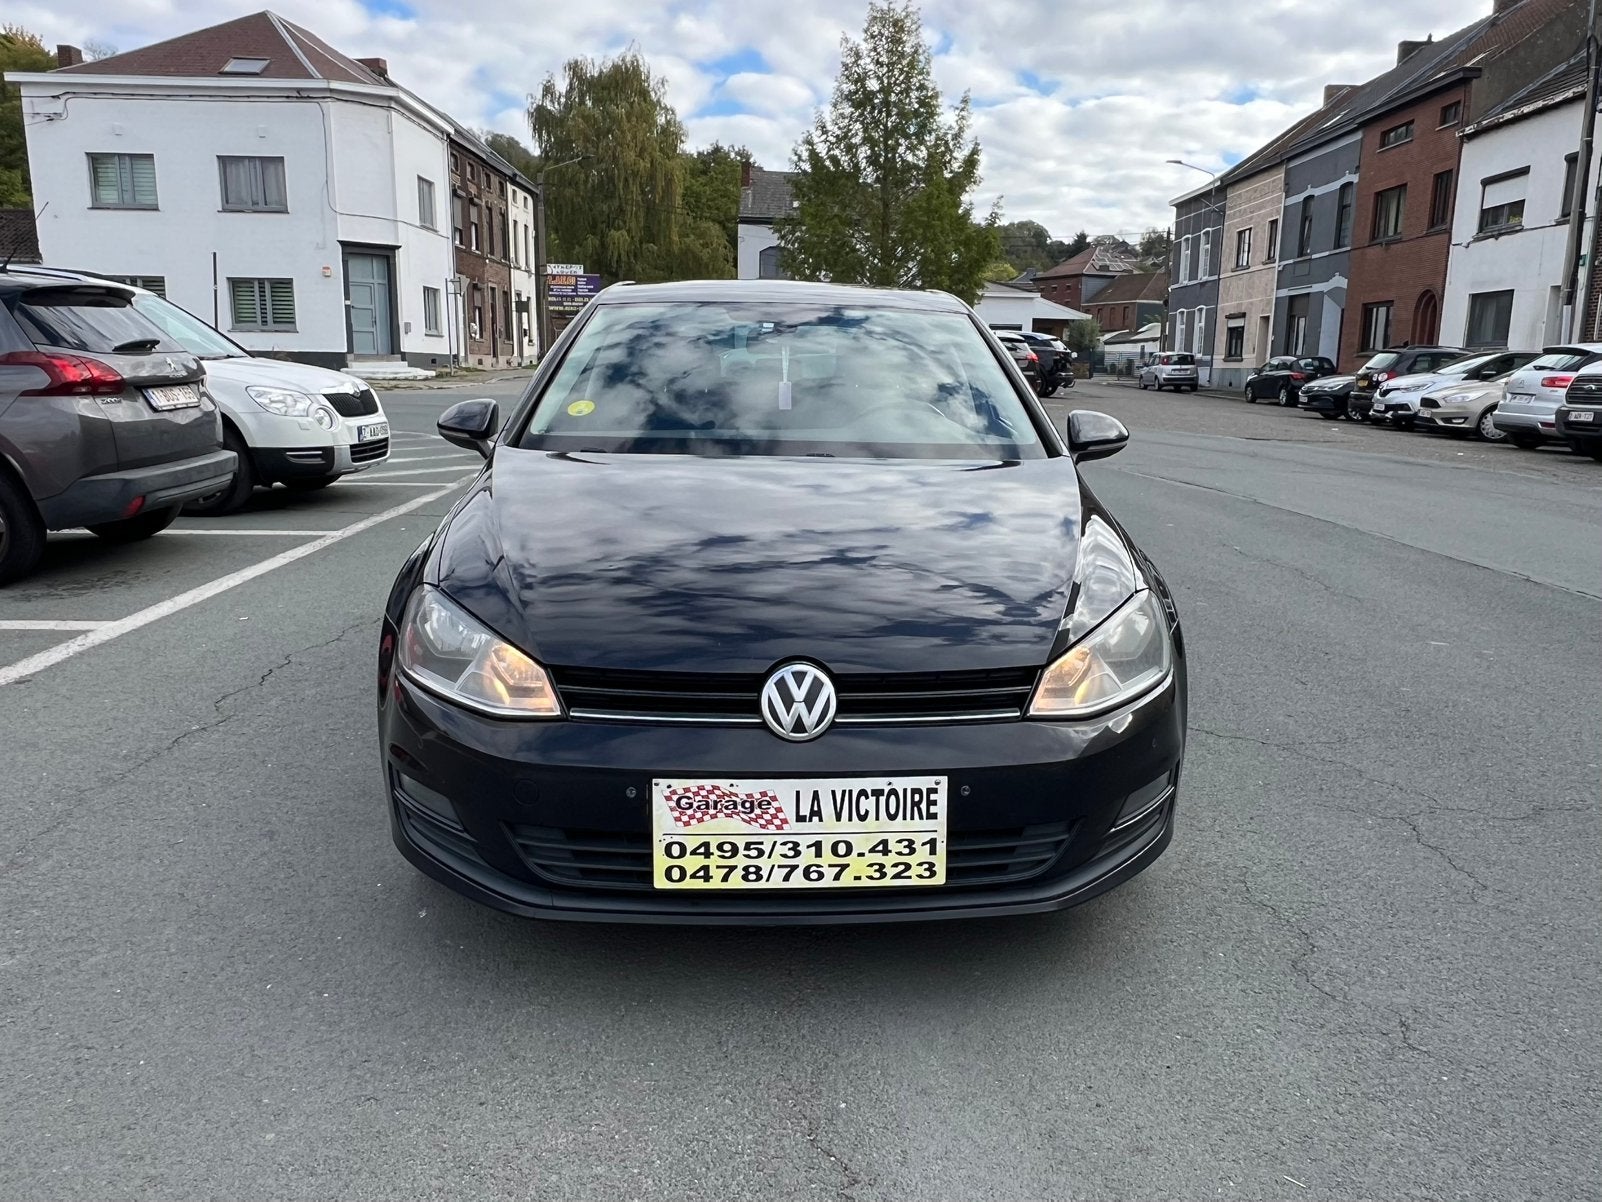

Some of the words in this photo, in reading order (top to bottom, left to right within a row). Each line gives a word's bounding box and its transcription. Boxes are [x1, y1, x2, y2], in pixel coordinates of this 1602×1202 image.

[675, 796, 772, 815] Garage
[795, 790, 824, 823] LA
[831, 788, 939, 822] VICTOIRE
[664, 838, 938, 860] 0495/310.431
[664, 861, 938, 883] 0478/767.323
